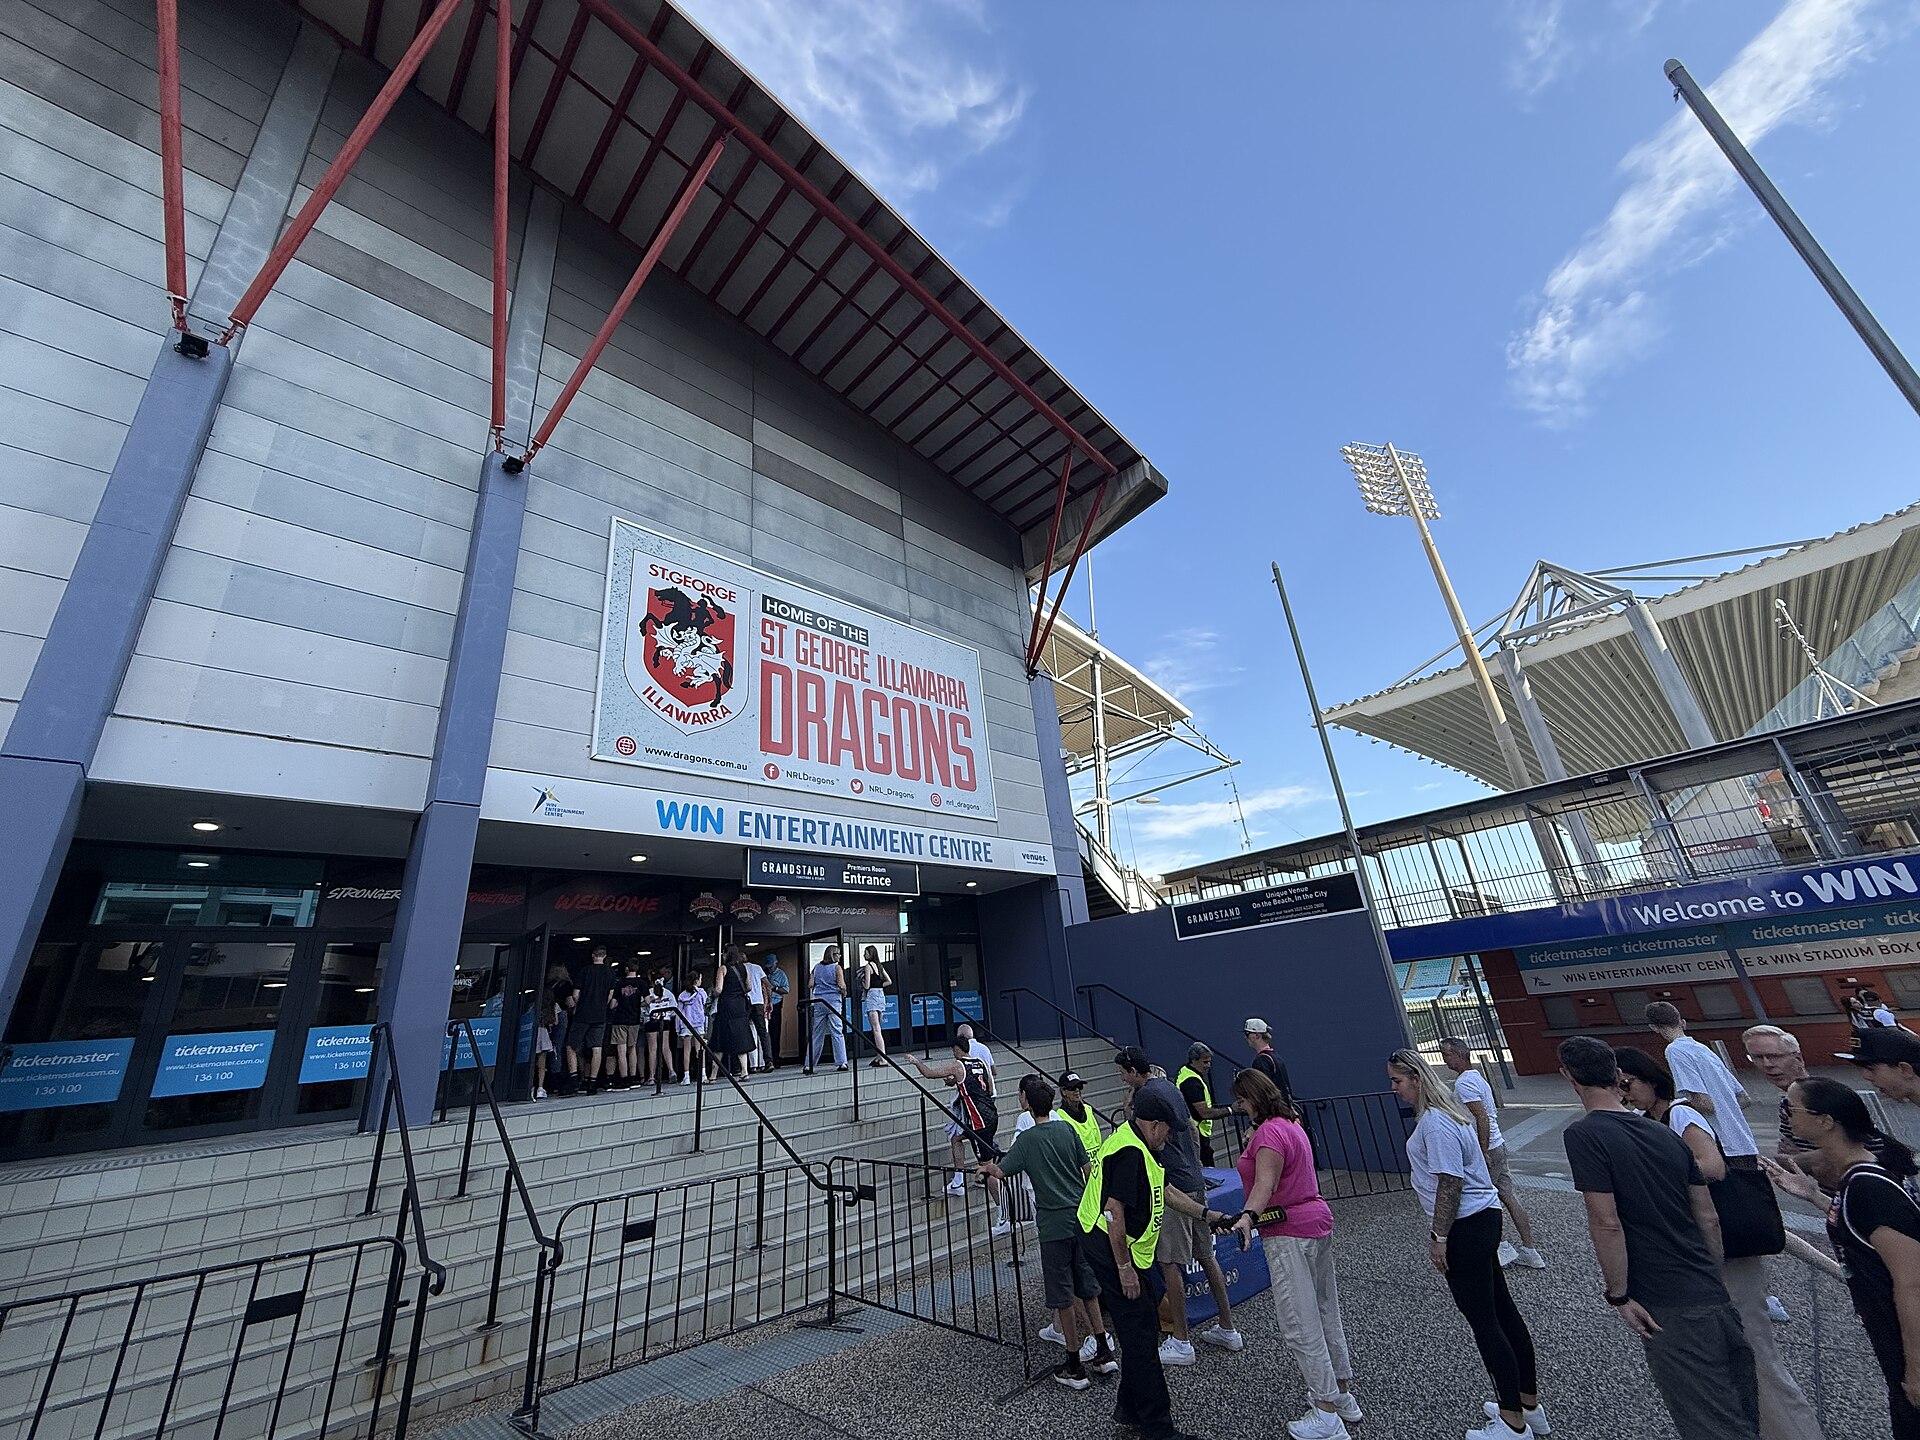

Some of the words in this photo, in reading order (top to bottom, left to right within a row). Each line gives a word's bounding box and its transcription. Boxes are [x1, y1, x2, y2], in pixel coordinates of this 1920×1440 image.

[649, 563, 737, 604] ST.GEORGE
[766, 599, 813, 626] HOME
[816, 616, 838, 632] OF
[840, 623, 867, 643] THE
[761, 617, 787, 659] ST
[795, 628, 871, 684] GEORGE
[877, 654, 970, 712] ILLAWARRA
[641, 685, 733, 726] ILLAWARRA
[760, 658, 977, 792] DRAGONS
[645, 746, 748, 771] www.dragons.com.au
[786, 769, 835, 786] NRLDragons
[869, 784, 915, 800] NRL_Dragons
[656, 799, 724, 835] WIN
[738, 810, 925, 857] ENTERTAINMENT
[929, 835, 994, 863] CENTRE
[761, 861, 825, 877] GRANDSTAND
[847, 864, 871, 872] Premiers
[872, 865, 887, 873] Room
[842, 871, 892, 887] Entrance
[327, 887, 402, 900] STRONGER
[1261, 900, 1272, 908] the
[1314, 890, 1328, 898] City
[1265, 890, 1288, 899] Unique
[1288, 886, 1309, 895] Venue
[1633, 894, 1765, 926] Welcome
[1770, 889, 1804, 909] to
[1802, 862, 1919, 903] WIN
[554, 893, 660, 914] WELCOME
[804, 906, 840, 915] STRONGER
[1187, 907, 1241, 925] GRANDSTAND
[1528, 945, 1614, 964] ticketmaster
[1621, 934, 1718, 954] ticketmaster
[1752, 918, 1866, 940] ticketmaster
[1883, 909, 1920, 927] tick
[1562, 973, 1587, 984] WIN
[1588, 962, 1693, 981] ENTERTAINMENT
[1697, 957, 1754, 972] CENTE
[1756, 956, 1769, 966] &
[1770, 952, 1801, 965] WIN
[1802, 946, 1874, 963] STADIUM
[1877, 942, 1915, 956] BOX
[453, 978, 472, 987] AWKS
[316, 1035, 374, 1047] ticketmas
[174, 1042, 260, 1057] ticketmaster
[309, 1050, 372, 1060] www.ticketmaster.c
[460, 1051, 473, 1060] 100
[12, 1052, 115, 1068] ticketmaster
[165, 1058, 265, 1071] www.ticketmaster.com.au
[334, 1061, 350, 1070] 136
[351, 1060, 366, 1069] 100
[0, 1069, 120, 1084] www.ticketmaster.com.au
[194, 1073, 212, 1082] 136
[215, 1071, 234, 1080] 100
[34, 1086, 56, 1096] 136
[61, 1084, 82, 1093] 100
[1257, 1210, 1280, 1222] RRETT
